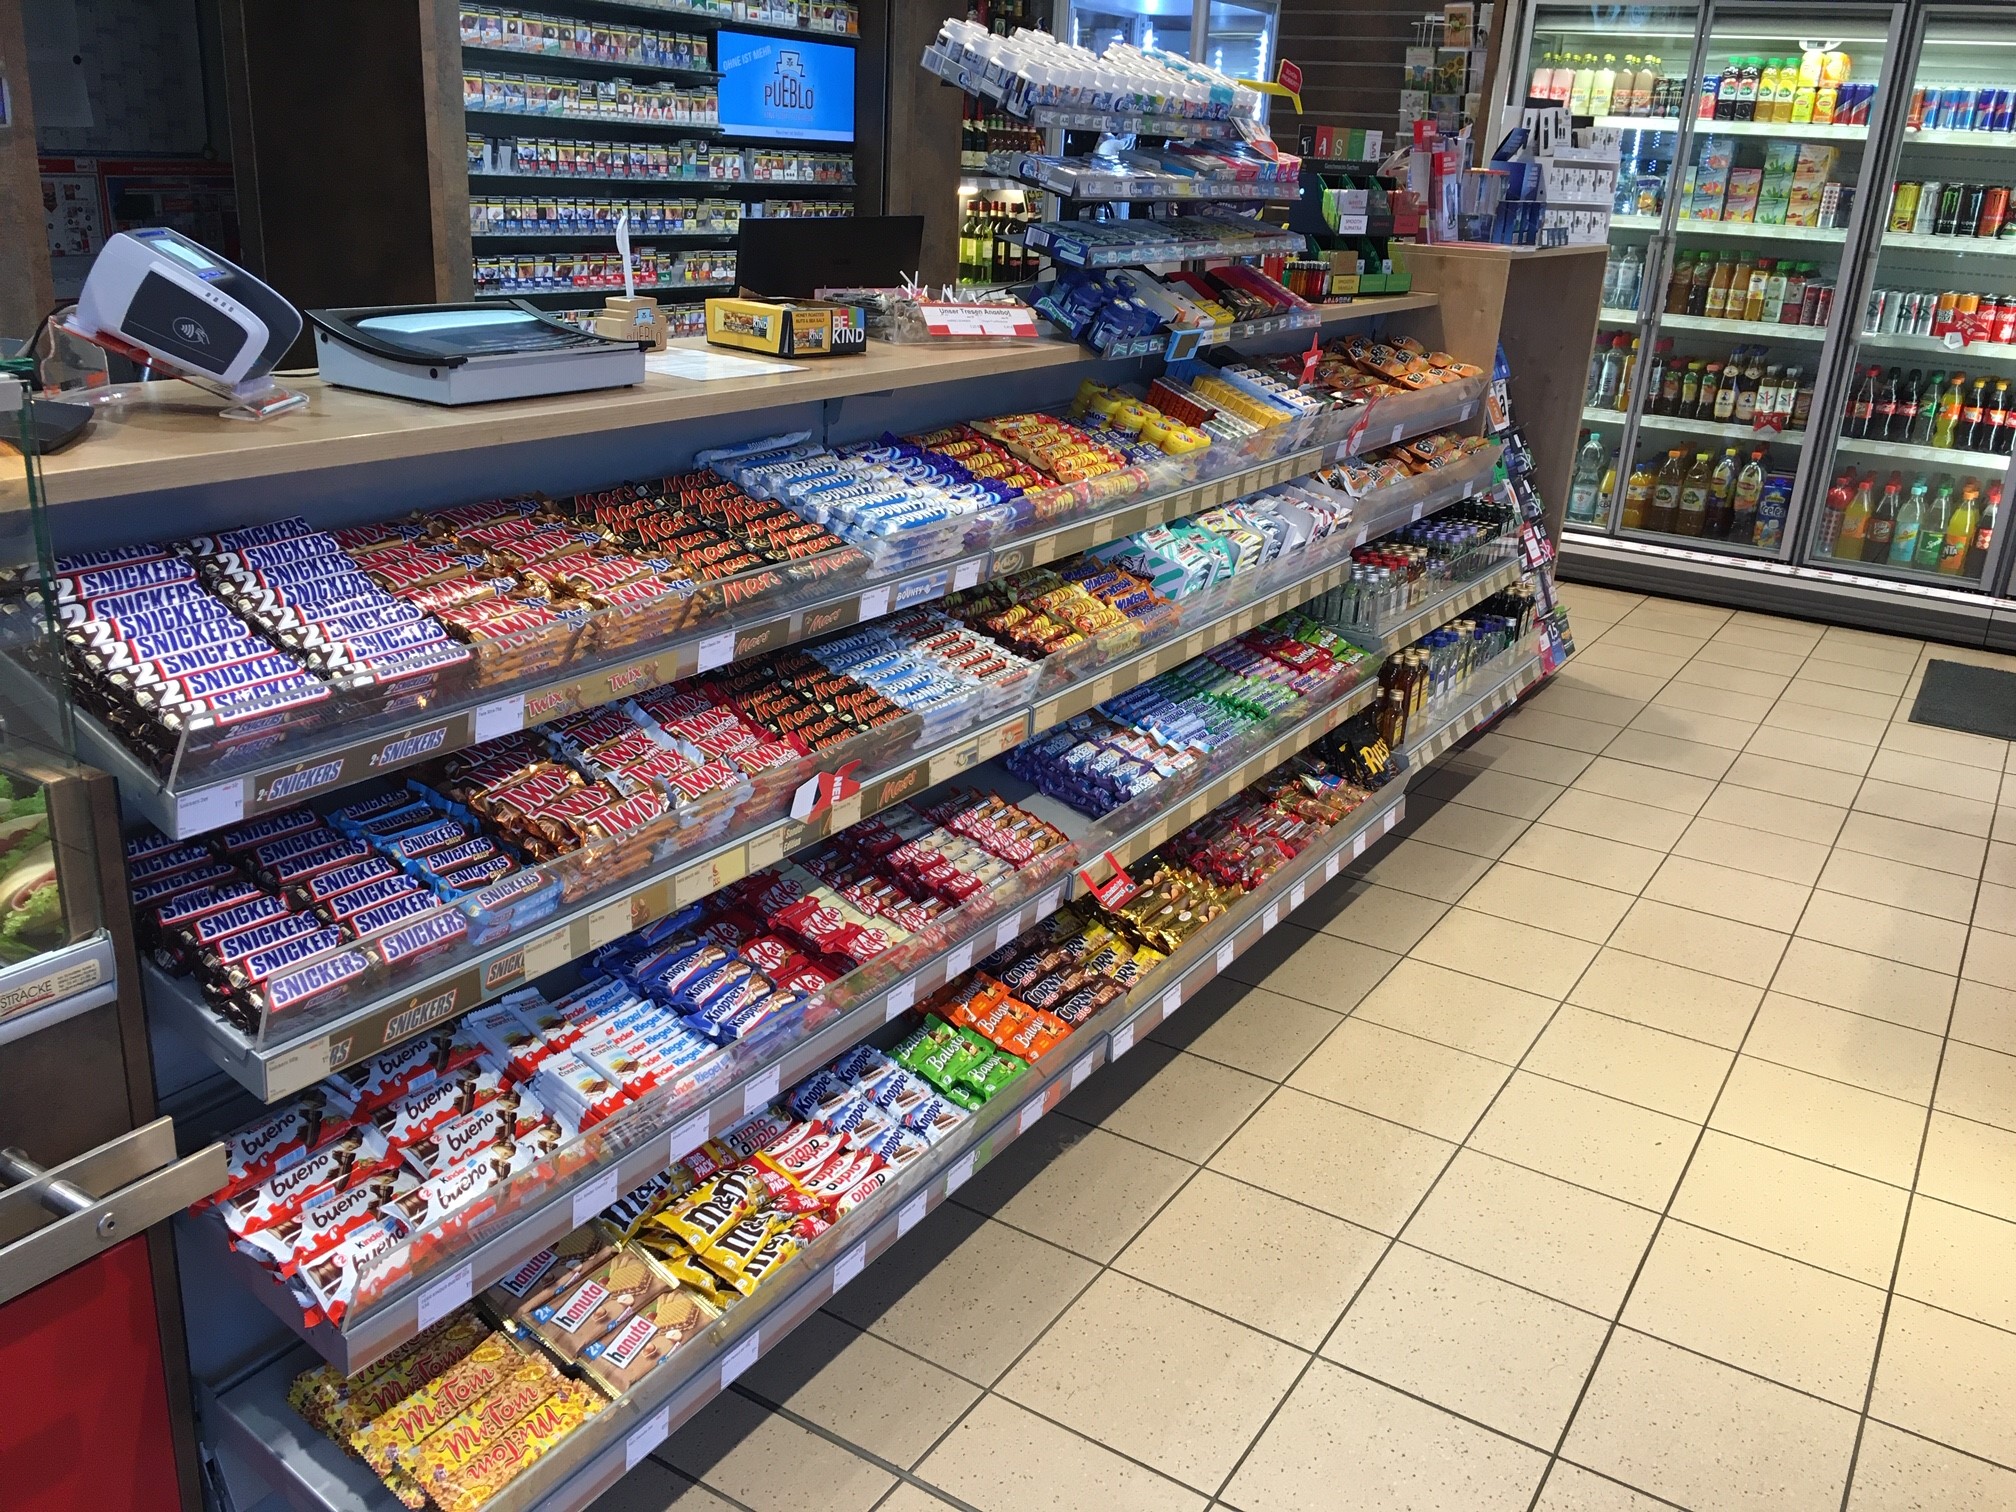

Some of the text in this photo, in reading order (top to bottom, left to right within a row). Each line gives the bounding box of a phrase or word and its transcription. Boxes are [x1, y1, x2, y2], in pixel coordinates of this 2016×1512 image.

[723, 45, 772, 71] OHNE IST MEHR
[764, 75, 814, 109] PUEBLO
[832, 329, 864, 343] KIND
[663, 468, 720, 494] Mars
[680, 482, 739, 507] Mars
[803, 473, 853, 491] BOUNTY
[820, 483, 874, 501] BOUNTY
[595, 499, 656, 525] Mars
[727, 500, 780, 527] Mars
[854, 491, 906, 506] BOUNTY
[873, 499, 924, 516] BOUNTY
[898, 506, 946, 524] BOUNTY
[222, 517, 312, 550] SNICKERS
[456, 519, 541, 544] TWIX
[746, 512, 800, 538] Mars
[769, 523, 824, 549] Mars
[247, 532, 339, 570] SNICKERS
[493, 530, 579, 564] TWIX
[682, 540, 742, 569] Mars
[1943, 545, 1958, 555] NTA
[85, 556, 194, 599] SNICKERS
[264, 552, 358, 589] SNICKERS
[365, 551, 458, 587] TWIX
[519, 553, 602, 583] TWIX
[564, 555, 646, 591] TWIX
[283, 570, 374, 607] SNICKERS
[722, 572, 782, 608] Mars
[84, 596, 231, 647] 2 SNICKERS
[102, 616, 247, 670] 2 SNICKERS
[322, 616, 445, 668] 2 SNICKERS
[919, 630, 960, 648] BOUNTY
[163, 635, 272, 678] SNICKERS
[855, 652, 901, 672] BOUNTY
[870, 662, 916, 681] BOUNTY
[950, 649, 992, 667] BOUNTY
[154, 652, 299, 706] 2 SNICKERS
[608, 665, 642, 692] Twix
[814, 675, 856, 701] Mars
[886, 671, 933, 692] BOUNTY
[526, 691, 564, 718] Twix
[754, 693, 800, 721] Mars
[835, 686, 878, 712] Mars
[666, 706, 733, 740] TWIX
[778, 703, 820, 734] Mars
[379, 728, 446, 766] SNICKERS
[586, 732, 655, 770] TWIX
[700, 724, 754, 759] TWIX
[729, 740, 796, 772] TWIX
[1067, 745, 1094, 763] Tender
[1360, 739, 1390, 774] RIES
[452, 748, 541, 790] TWIX
[619, 751, 690, 786] TWIX
[670, 759, 734, 798] TWIX
[1092, 751, 1120, 773] Tender
[267, 760, 344, 800] SNICKERS
[487, 767, 571, 814] TWIX
[881, 770, 916, 800] Mars
[1129, 772, 1155, 796] Tender
[528, 784, 611, 822] TWIX
[227, 809, 316, 847] SNICKERS
[402, 822, 463, 854] SNICKERS
[429, 838, 493, 869] SNICKERS
[473, 851, 490, 861] CRISP
[314, 857, 392, 898] SNICKER
[448, 855, 510, 887] SNICKERS
[333, 876, 418, 918] SNICKERS
[479, 872, 540, 906] SNICKERS
[222, 909, 316, 960] SNICKERS
[383, 909, 465, 958] SNICKERS
[810, 906, 840, 934] KitKat
[252, 926, 340, 979] SNICKERS
[659, 952, 700, 983] Knoppers
[271, 952, 369, 999] SNICKERS
[488, 952, 525, 989] SNICK
[686, 968, 726, 999] Knoppers
[1001, 952, 1043, 988] CORNY
[1021, 971, 1038, 986] BIG
[0, 980, 52, 1008] STRACKE
[586, 989, 613, 1010] Riegel
[704, 984, 745, 1022] Knoppers
[1024, 972, 1062, 1007] CORNY
[1054, 986, 1093, 1024] CORNY
[384, 989, 457, 1045] SNICKERS
[612, 1014, 661, 1046] inder Riegel
[979, 1001, 1011, 1035] Balisto
[1014, 1016, 1045, 1048] Balisto
[378, 1038, 429, 1075] bueno
[628, 1026, 674, 1055] nder Riegel
[660, 1038, 689, 1058] Riegel
[899, 1023, 930, 1060] Balisto
[926, 1034, 964, 1072] Balisto
[674, 1049, 702, 1068] Riegel
[404, 1081, 454, 1119] bueno
[241, 1112, 296, 1154] bueno
[446, 1112, 495, 1150] bueno
[729, 1117, 767, 1146] duplo
[911, 1100, 943, 1135] Knoppe
[740, 1124, 777, 1154] duplo
[271, 1154, 329, 1197] bueno
[694, 1159, 715, 1178] PACK
[437, 1163, 488, 1209] bueno
[769, 1177, 790, 1195] PACK
[851, 1172, 886, 1203] duplo
[311, 1188, 368, 1228] bueno
[509, 1252, 551, 1293] hanuta
[537, 1284, 604, 1327] 2x hanuta
[588, 1319, 651, 1364] 2x hanuta
